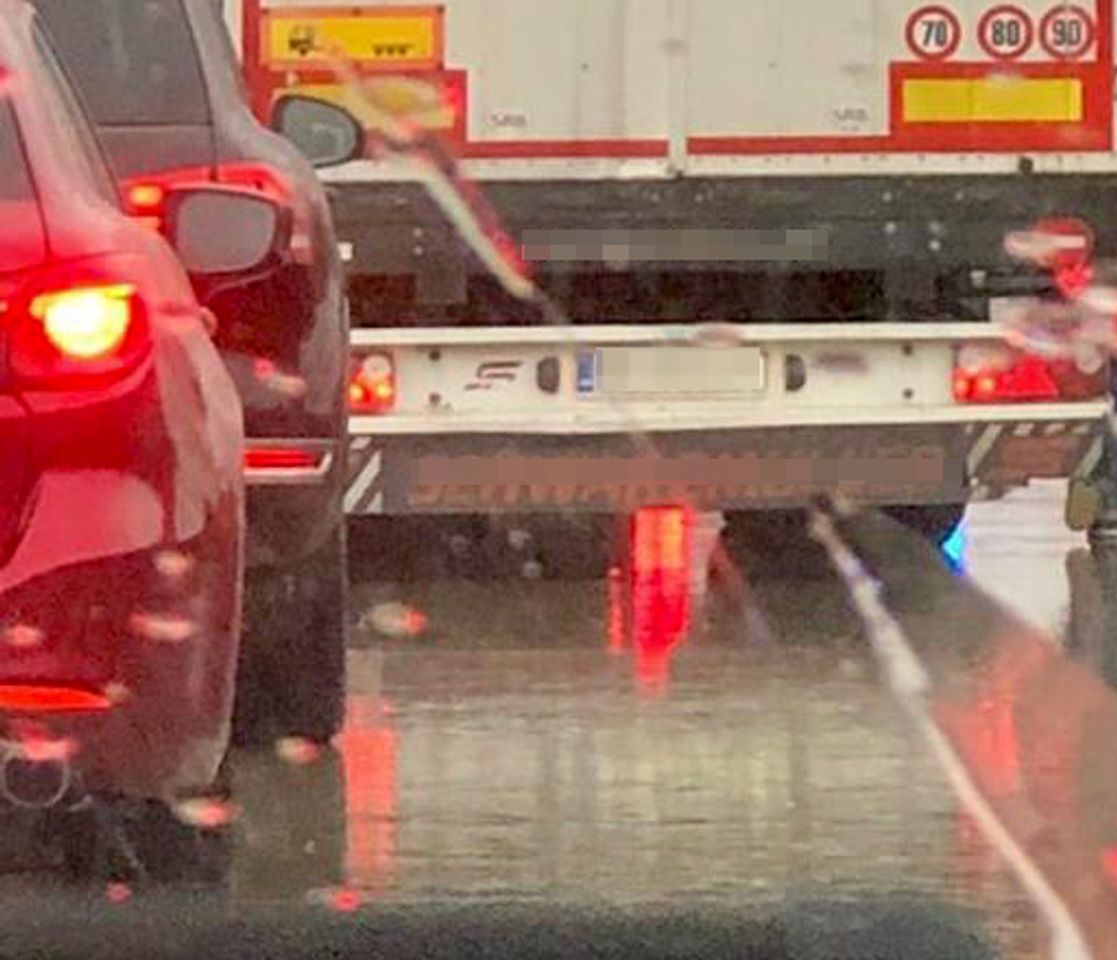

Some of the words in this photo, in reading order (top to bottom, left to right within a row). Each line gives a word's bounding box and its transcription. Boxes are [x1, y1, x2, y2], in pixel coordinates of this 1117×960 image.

[921, 19, 948, 47] 70
[991, 19, 1021, 47] 80
[1051, 19, 1082, 46] 90
